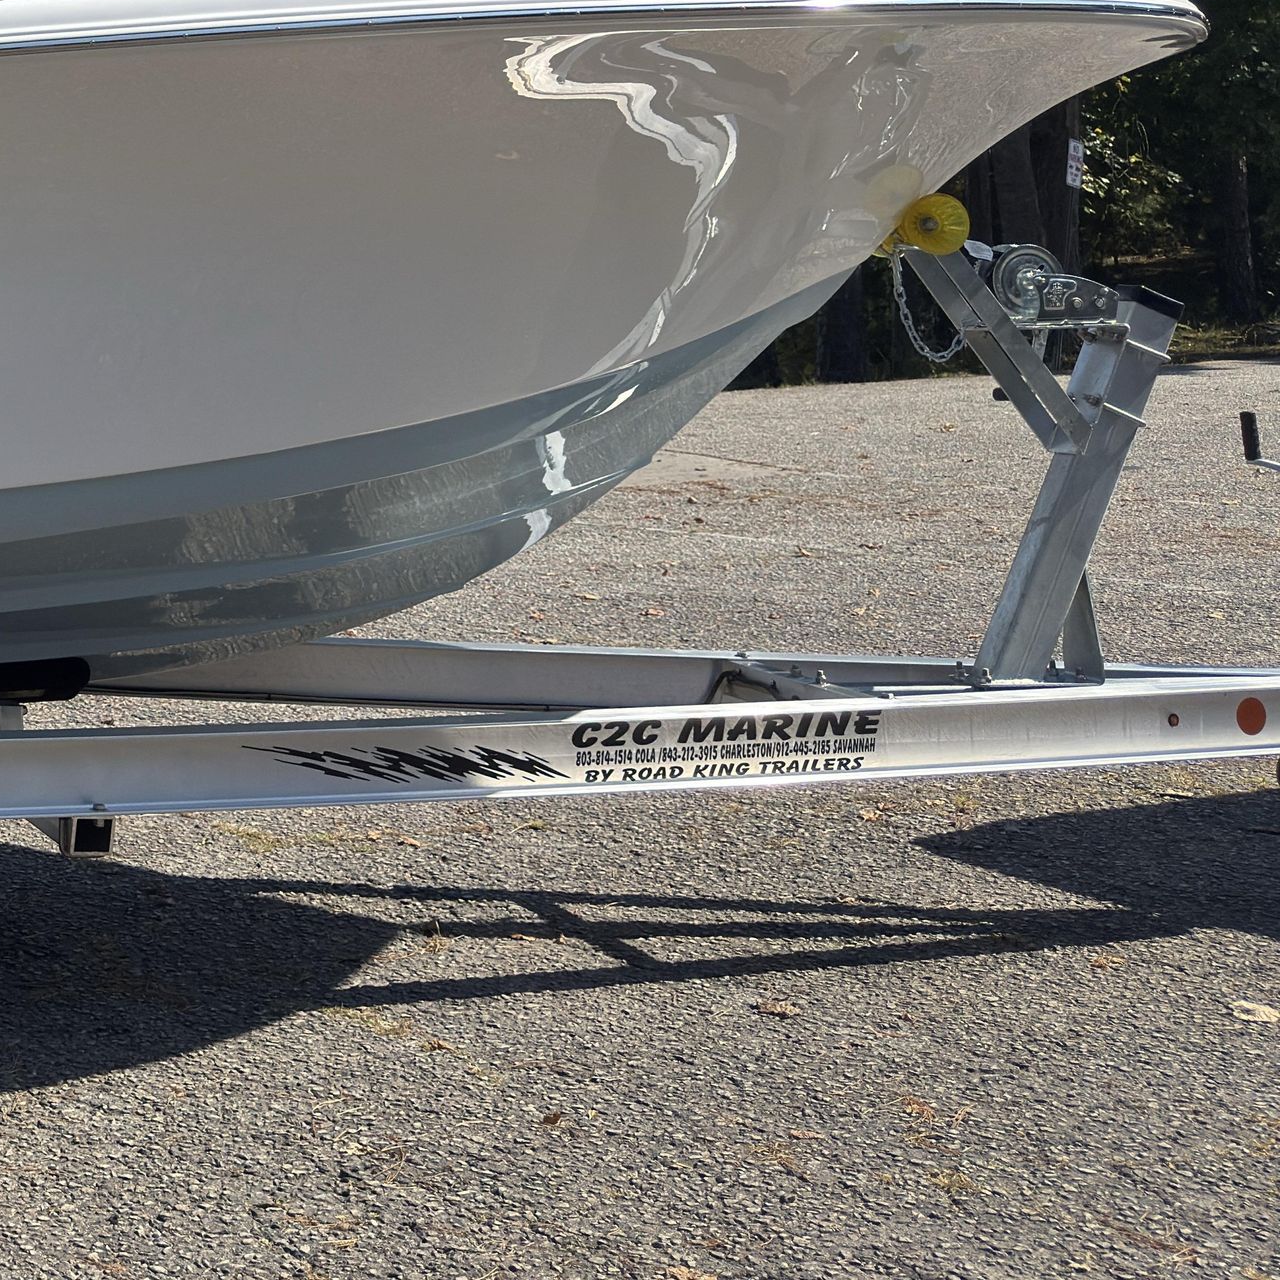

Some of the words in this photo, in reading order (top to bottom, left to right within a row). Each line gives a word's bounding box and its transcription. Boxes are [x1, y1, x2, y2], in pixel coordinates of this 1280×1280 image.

[572, 720, 662, 748] C2C
[677, 710, 882, 743] MARINE
[576, 750, 633, 766] 803-814-1514
[635, 748, 656, 763] COLA
[833, 737, 876, 754] SAVANNAH
[584, 768, 614, 783] BY
[622, 766, 684, 782] ROAD
[693, 763, 750, 778] KING
[759, 756, 865, 774] TRAILERS
